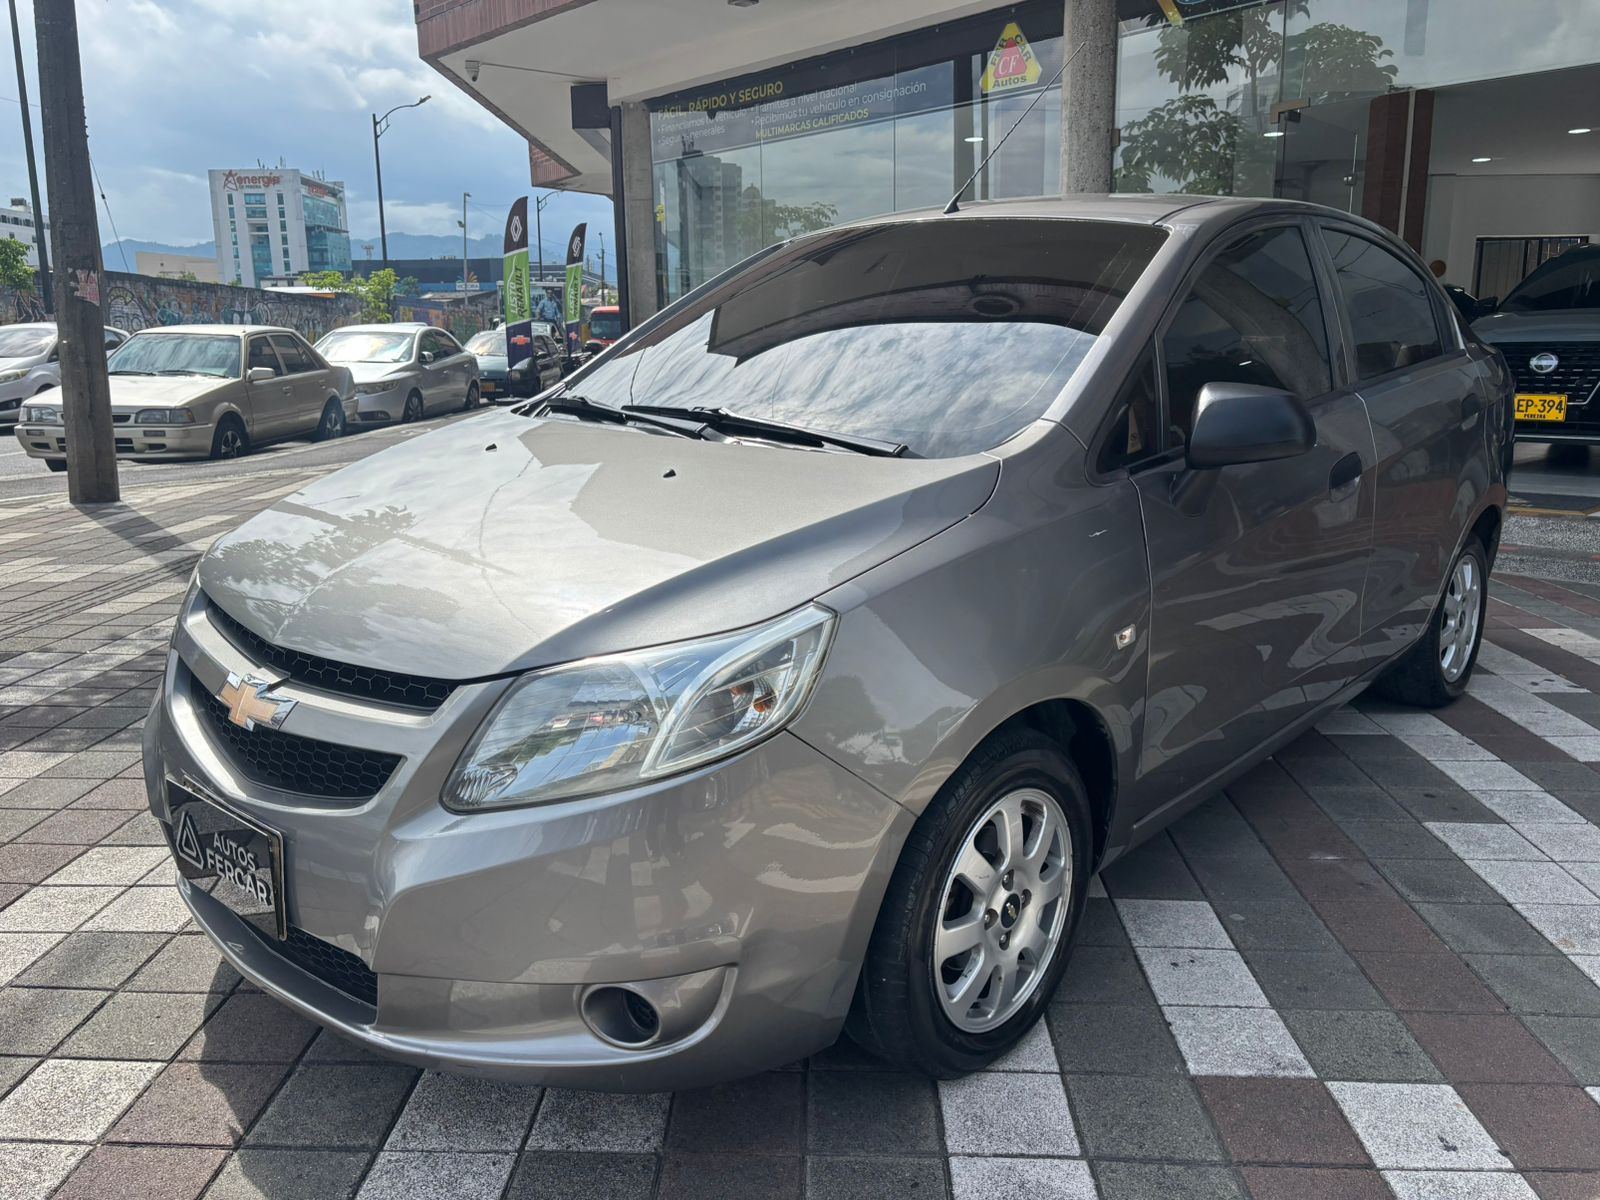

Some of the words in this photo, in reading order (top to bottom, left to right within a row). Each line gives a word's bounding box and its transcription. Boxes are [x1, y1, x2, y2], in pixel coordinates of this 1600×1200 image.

[999, 54, 1020, 75] CF
[819, 82, 857, 99] nacional
[848, 96, 860, 106] en
[862, 81, 927, 104] consignación
[992, 75, 1027, 88] Autos
[688, 94, 727, 112] RÁPIDO
[729, 91, 737, 104] Y
[739, 81, 784, 103] SEGURO
[755, 119, 811, 139] MULTIMARCAS
[812, 108, 869, 128] CALIFICADOS
[515, 265, 527, 318] RENAULT
[1516, 399, 1564, 413] EP-394
[213, 832, 256, 872] AUTOS
[206, 847, 269, 905] FERCAR
